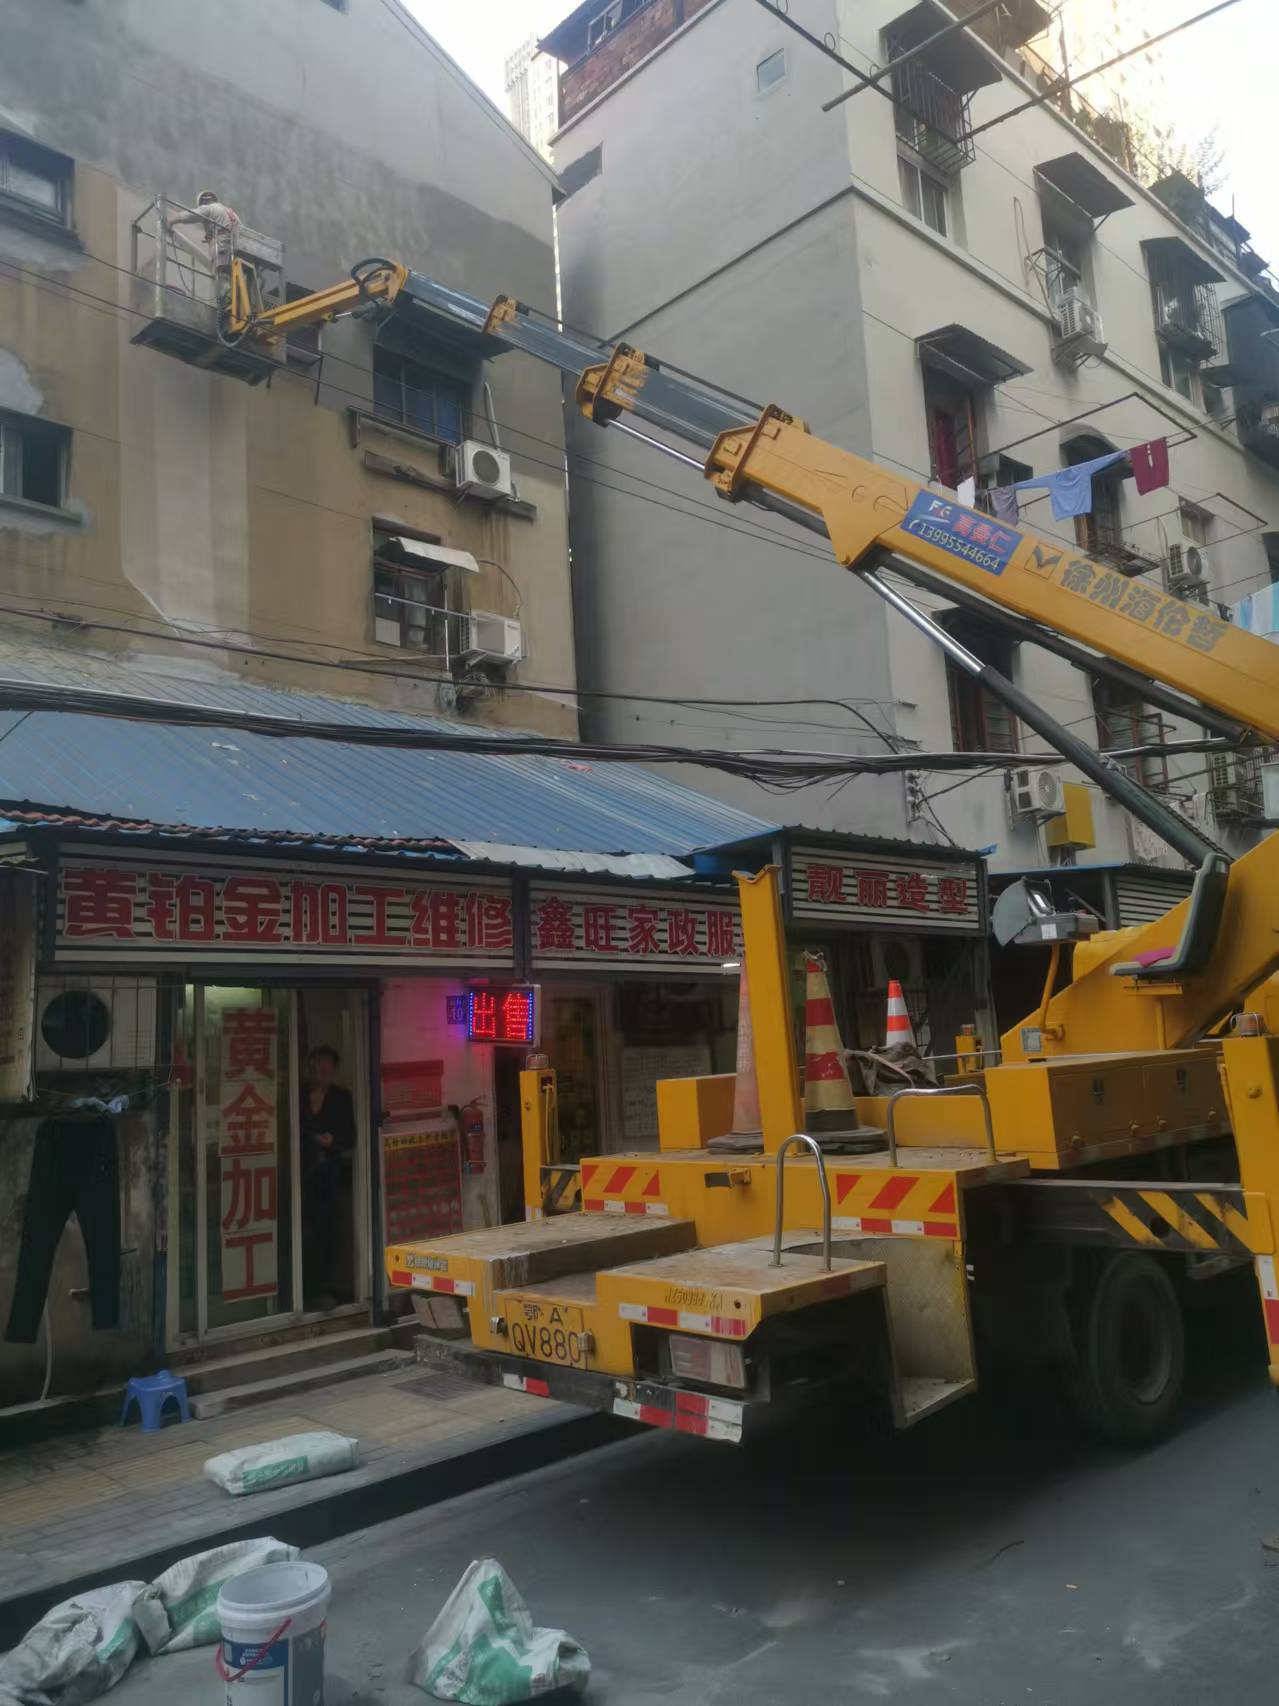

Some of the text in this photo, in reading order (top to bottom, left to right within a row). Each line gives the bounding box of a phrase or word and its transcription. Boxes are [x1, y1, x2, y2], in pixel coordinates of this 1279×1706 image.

[917, 521, 1001, 570] 13995544664
[1059, 559, 1229, 652] 徐州海伦哲
[63, 866, 513, 950] 黄铂金加工维修
[806, 864, 970, 915] 靓丽造型
[537, 899, 745, 958] 鑫旺家政服
[222, 1009, 278, 1302] 黄金加工
